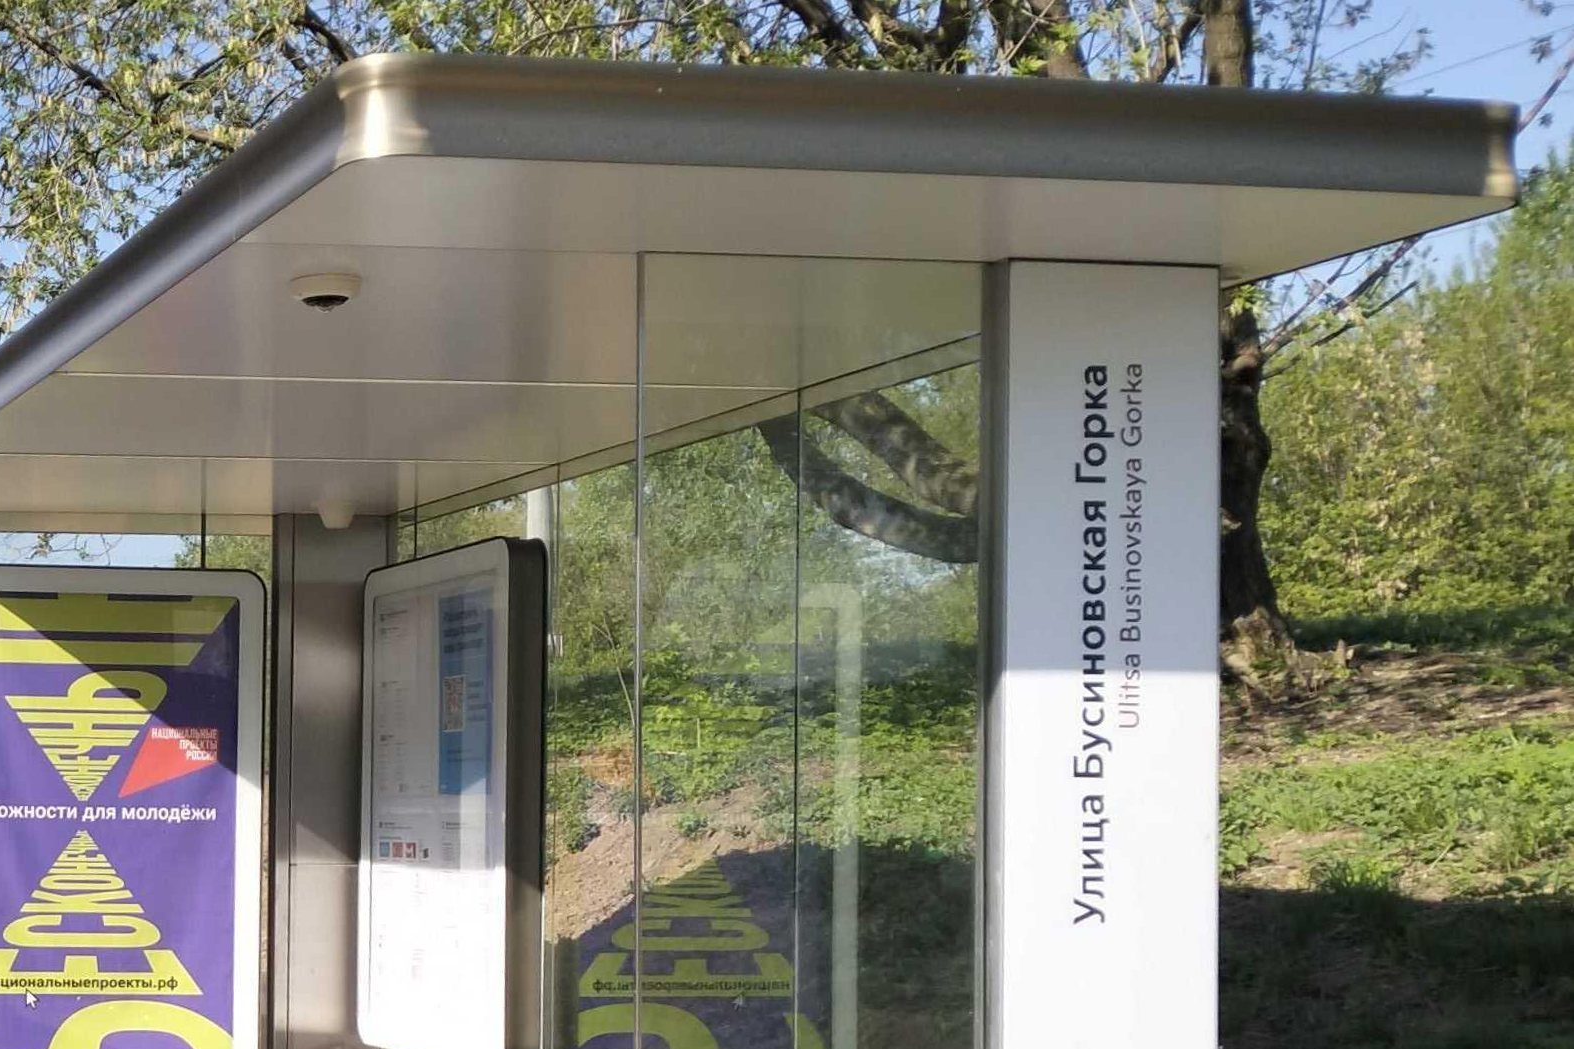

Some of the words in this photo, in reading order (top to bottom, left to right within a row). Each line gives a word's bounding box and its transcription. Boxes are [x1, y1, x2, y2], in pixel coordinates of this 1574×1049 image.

[1075, 363, 1115, 484] Горка
[1119, 362, 1143, 447] Gorka
[1118, 457, 1147, 643] Businovskaya
[1072, 500, 1113, 779] Бусиновская
[1118, 652, 1141, 729] Ulitsa
[81, 805, 117, 822] для
[120, 803, 217, 824] молодёжи
[1072, 794, 1110, 925] Улица
